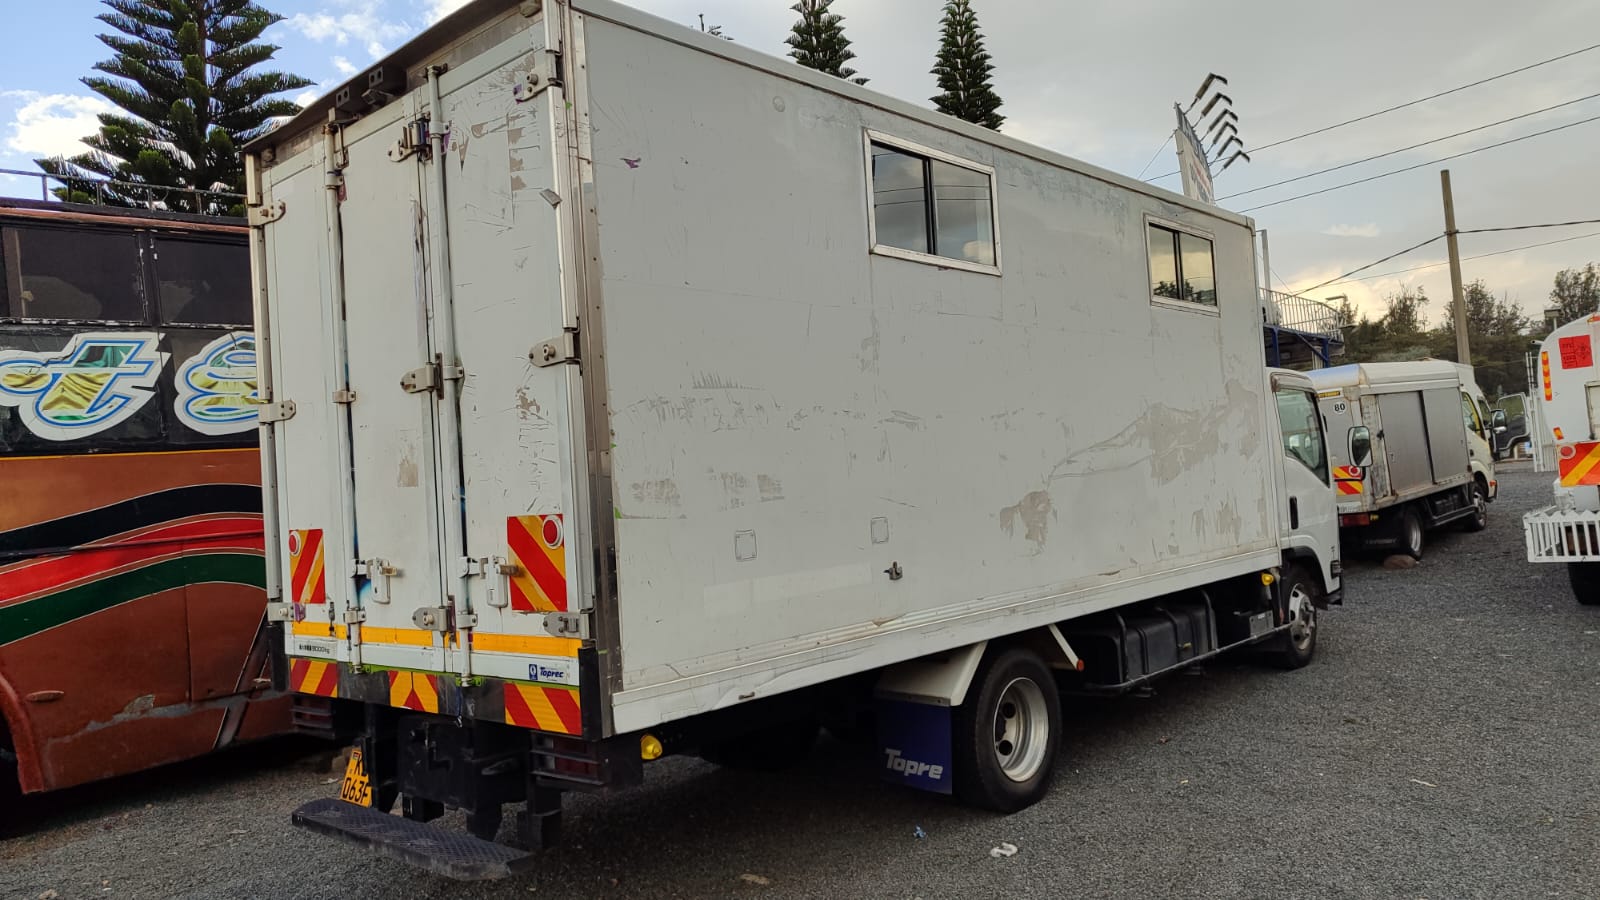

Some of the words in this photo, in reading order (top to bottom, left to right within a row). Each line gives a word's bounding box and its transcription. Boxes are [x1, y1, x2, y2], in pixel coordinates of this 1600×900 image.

[1334, 403, 1346, 412] 80
[540, 666, 564, 678] Toprec
[885, 747, 944, 780] Topre
